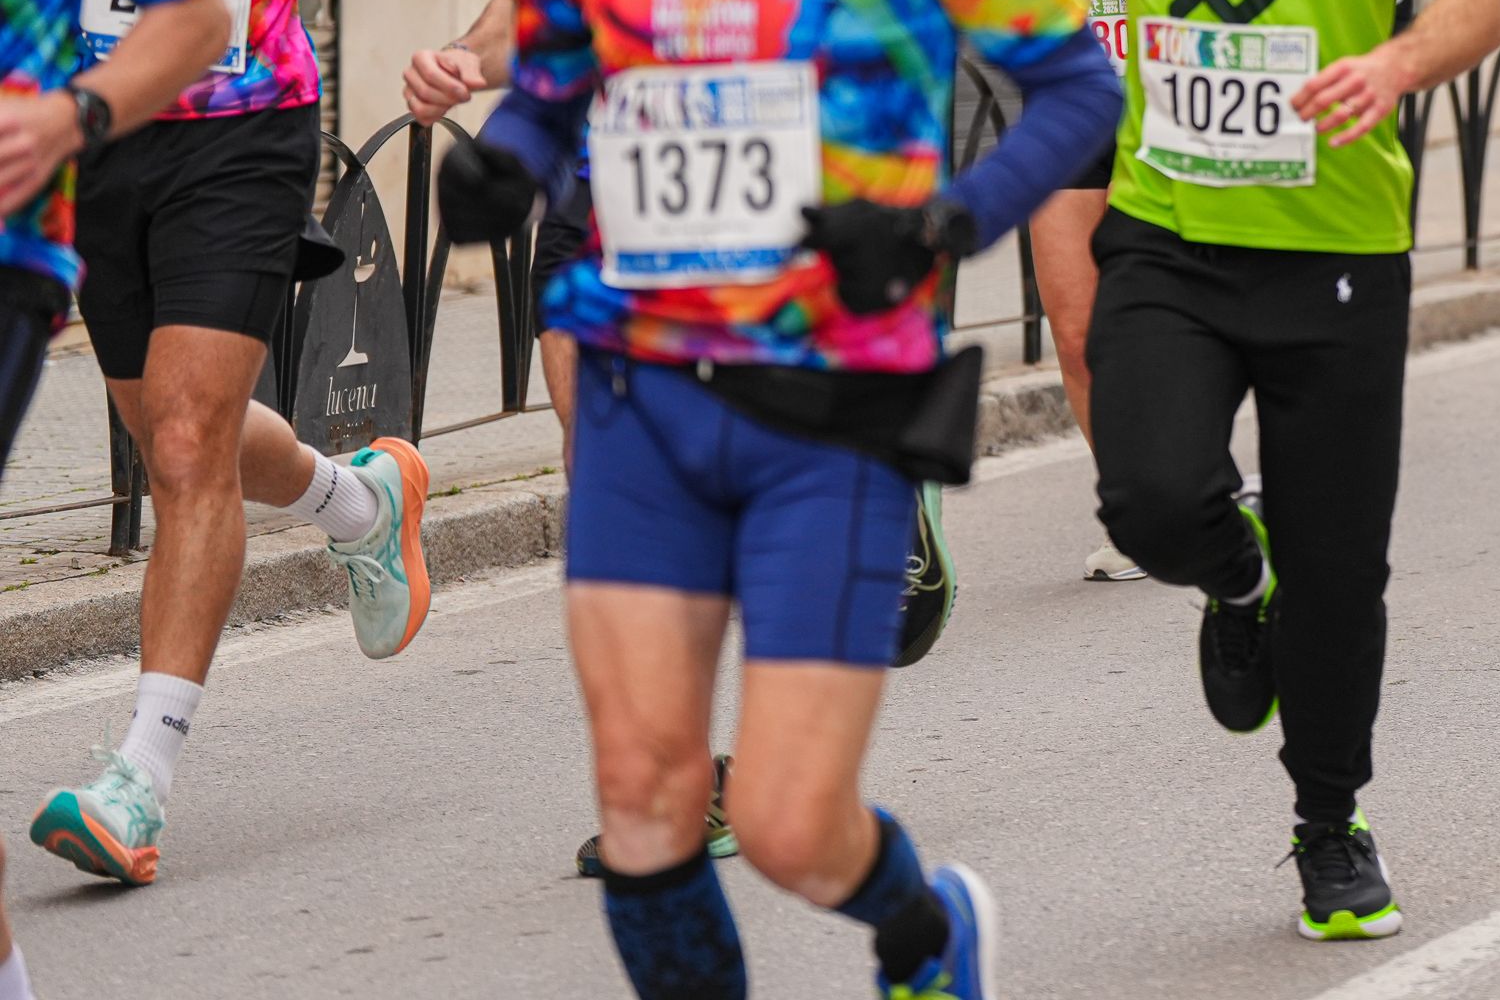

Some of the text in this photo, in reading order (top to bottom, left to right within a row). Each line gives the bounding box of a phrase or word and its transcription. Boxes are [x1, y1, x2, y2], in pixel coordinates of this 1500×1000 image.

[1163, 73, 1281, 136] 1026
[625, 138, 775, 216] 1373
[326, 376, 377, 416] lucena
